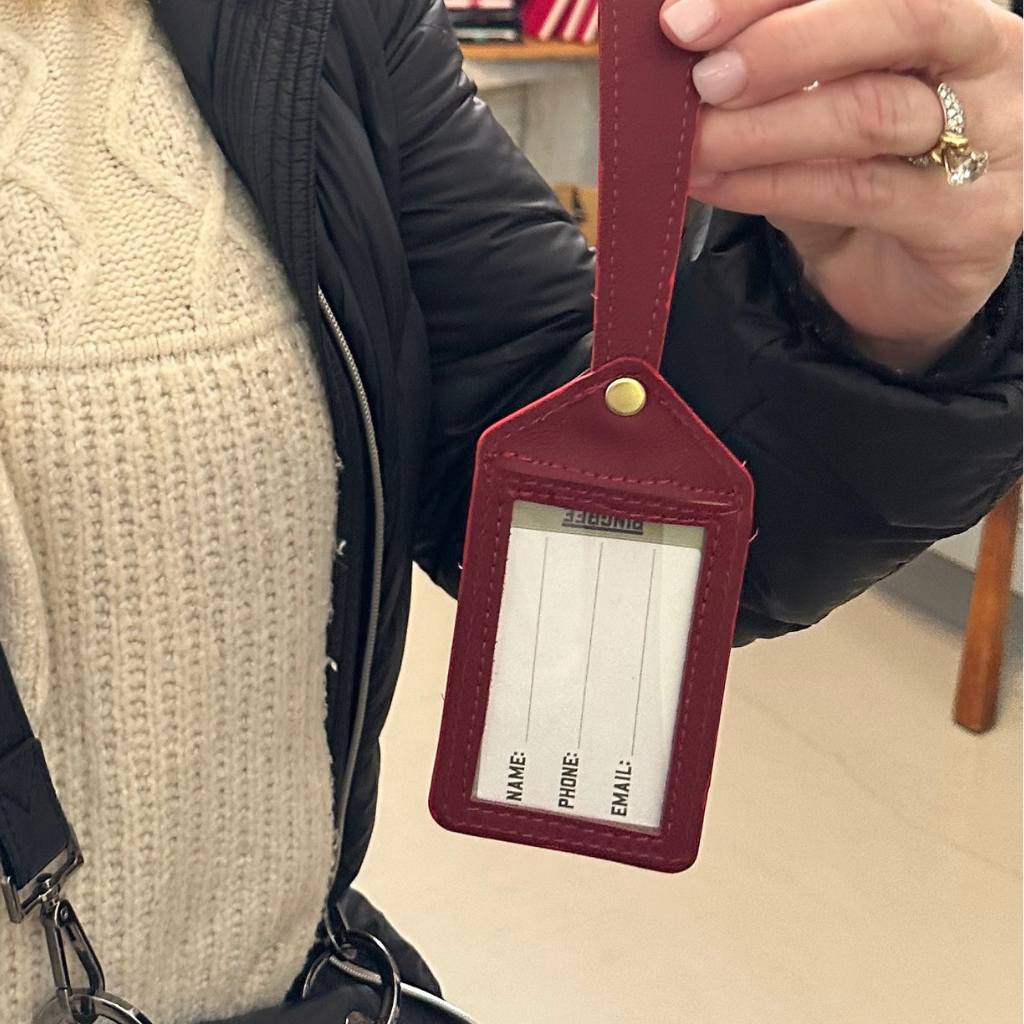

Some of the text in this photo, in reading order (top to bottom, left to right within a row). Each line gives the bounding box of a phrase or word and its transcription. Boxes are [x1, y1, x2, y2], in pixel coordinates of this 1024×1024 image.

[506, 751, 526, 802] NAME:
[558, 752, 580, 809] PHONE:
[611, 759, 632, 817] EMAIL:
